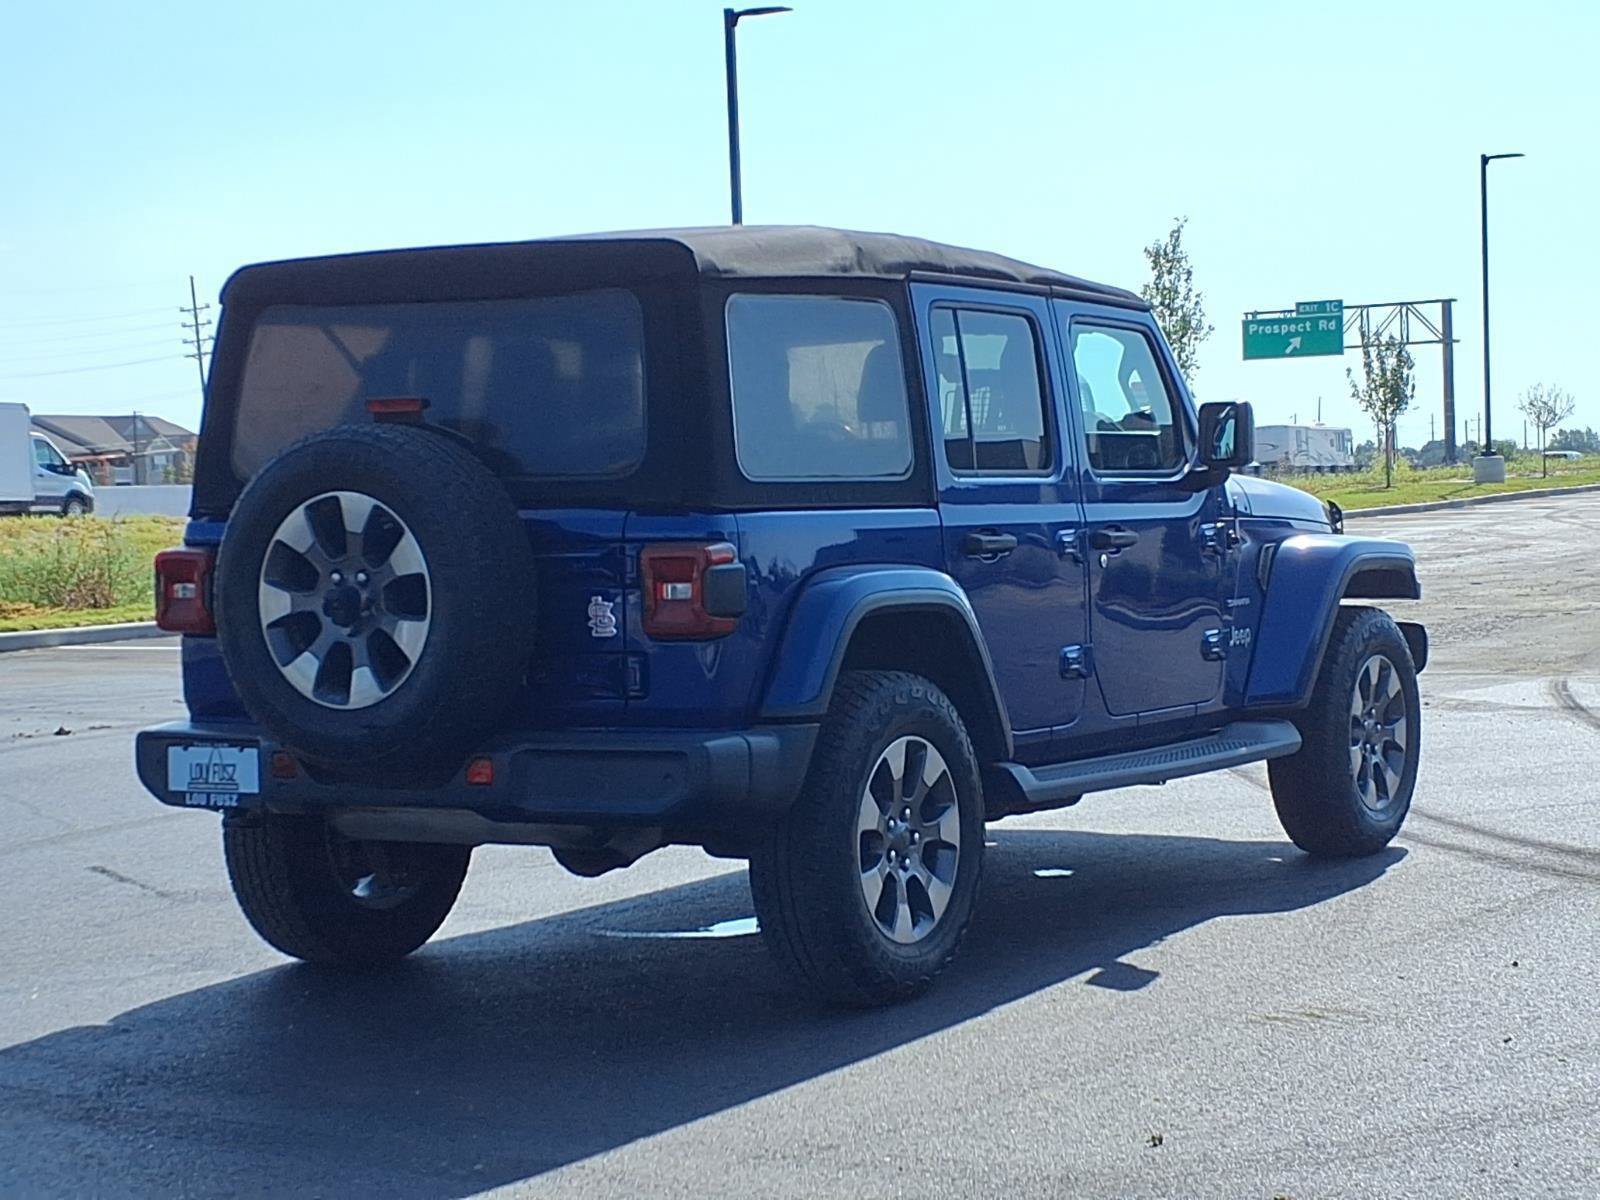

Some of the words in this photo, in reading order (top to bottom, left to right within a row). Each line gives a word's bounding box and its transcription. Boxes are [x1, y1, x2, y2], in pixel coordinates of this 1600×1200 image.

[1299, 304, 1318, 313] EXIT
[1326, 302, 1339, 312] 1C
[1249, 321, 1311, 335] Prospect
[1318, 320, 1336, 331] Rd
[1229, 626, 1250, 648] Jeep
[210, 794, 238, 806] FUSZ
